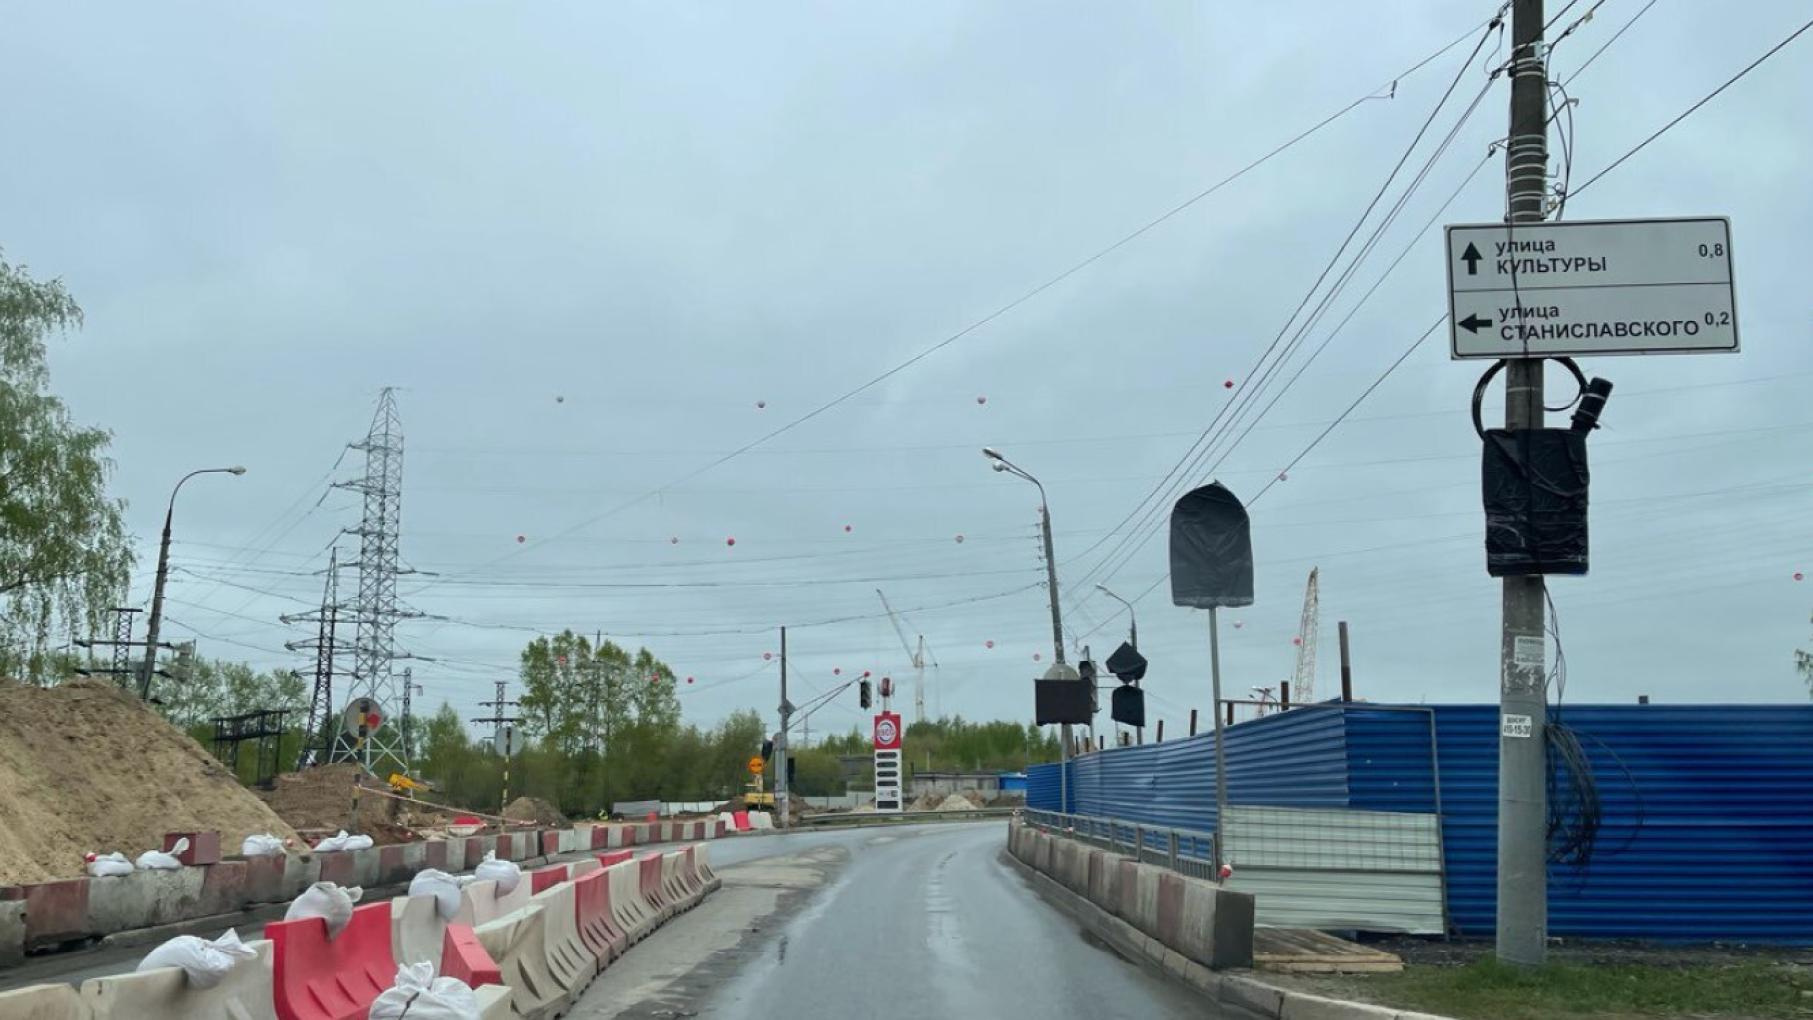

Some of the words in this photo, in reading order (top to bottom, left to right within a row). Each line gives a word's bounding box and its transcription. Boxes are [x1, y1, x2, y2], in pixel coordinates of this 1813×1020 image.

[1496, 240, 1555, 255] улица
[1699, 243, 1724, 258] 0,8
[1497, 256, 1607, 274] КУЛЬТУРЫ
[1499, 305, 1559, 321] улица
[1704, 311, 1730, 327] 0,2
[1501, 320, 1699, 341] СТАНИСЛАВСКОГО
